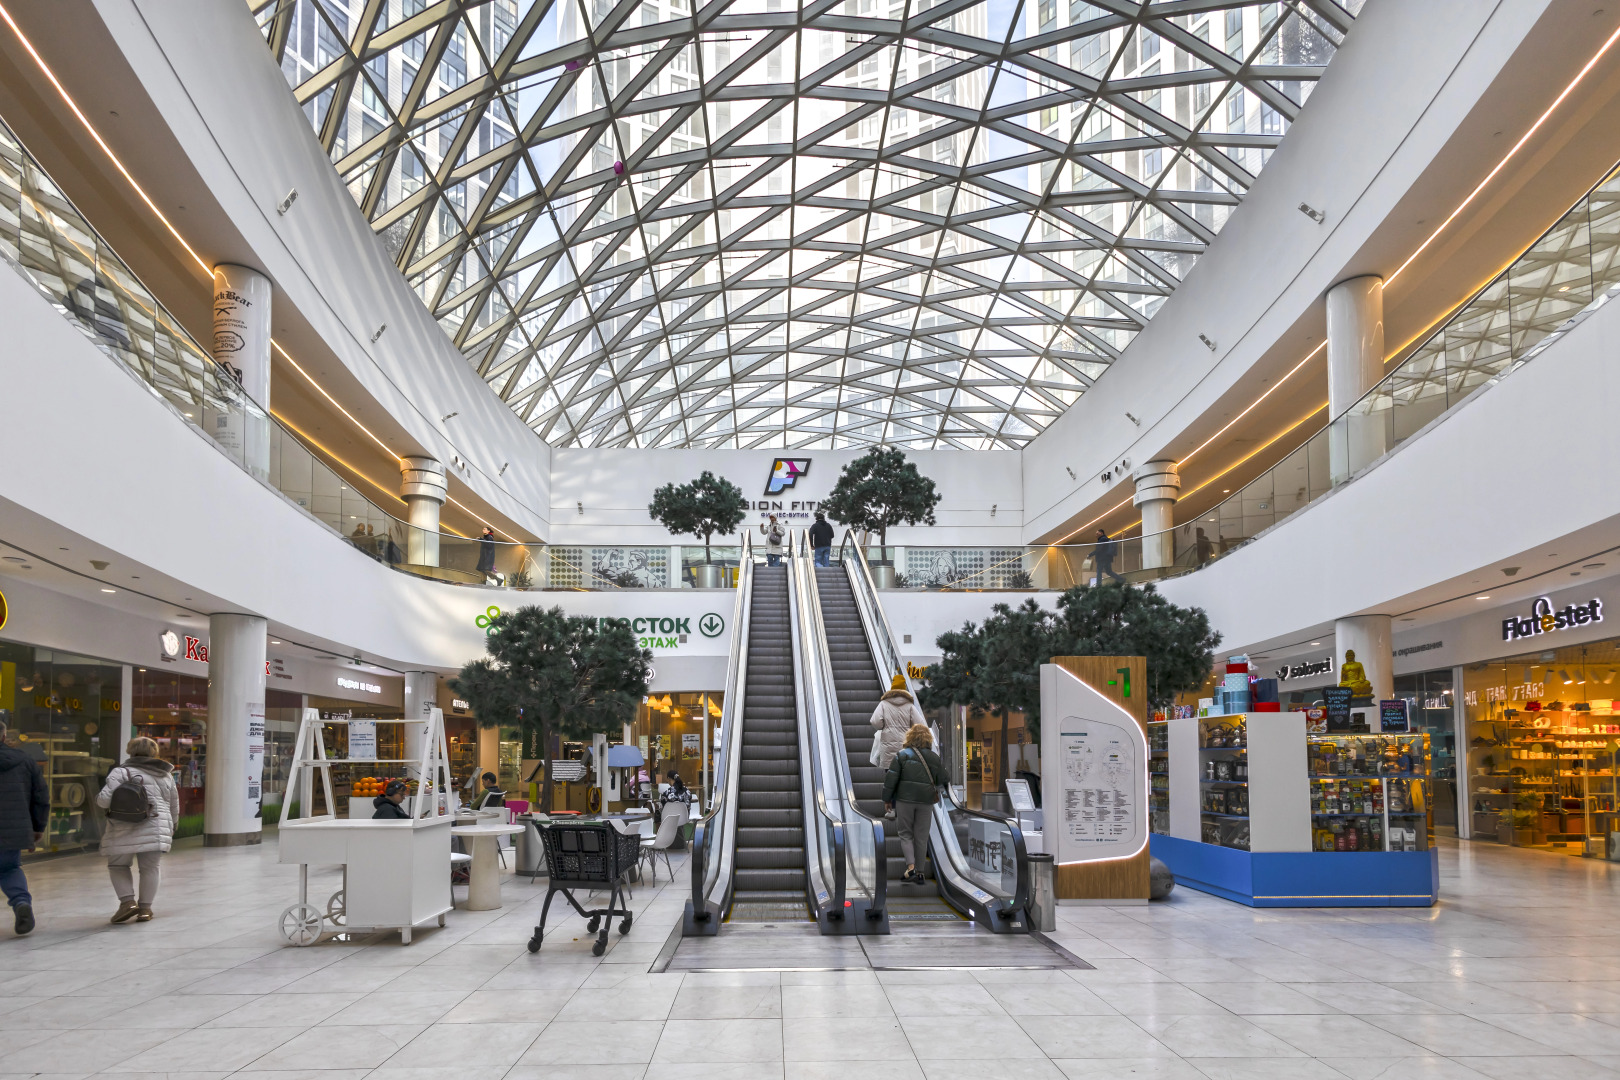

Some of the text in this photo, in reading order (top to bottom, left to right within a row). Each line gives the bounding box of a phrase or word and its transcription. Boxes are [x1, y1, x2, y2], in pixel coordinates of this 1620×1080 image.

[741, 501, 783, 511] SION
[639, 637, 679, 648] ЭТАЖ
[1398, 640, 1443, 657] окрашивания
[1107, 667, 1131, 698] -1
